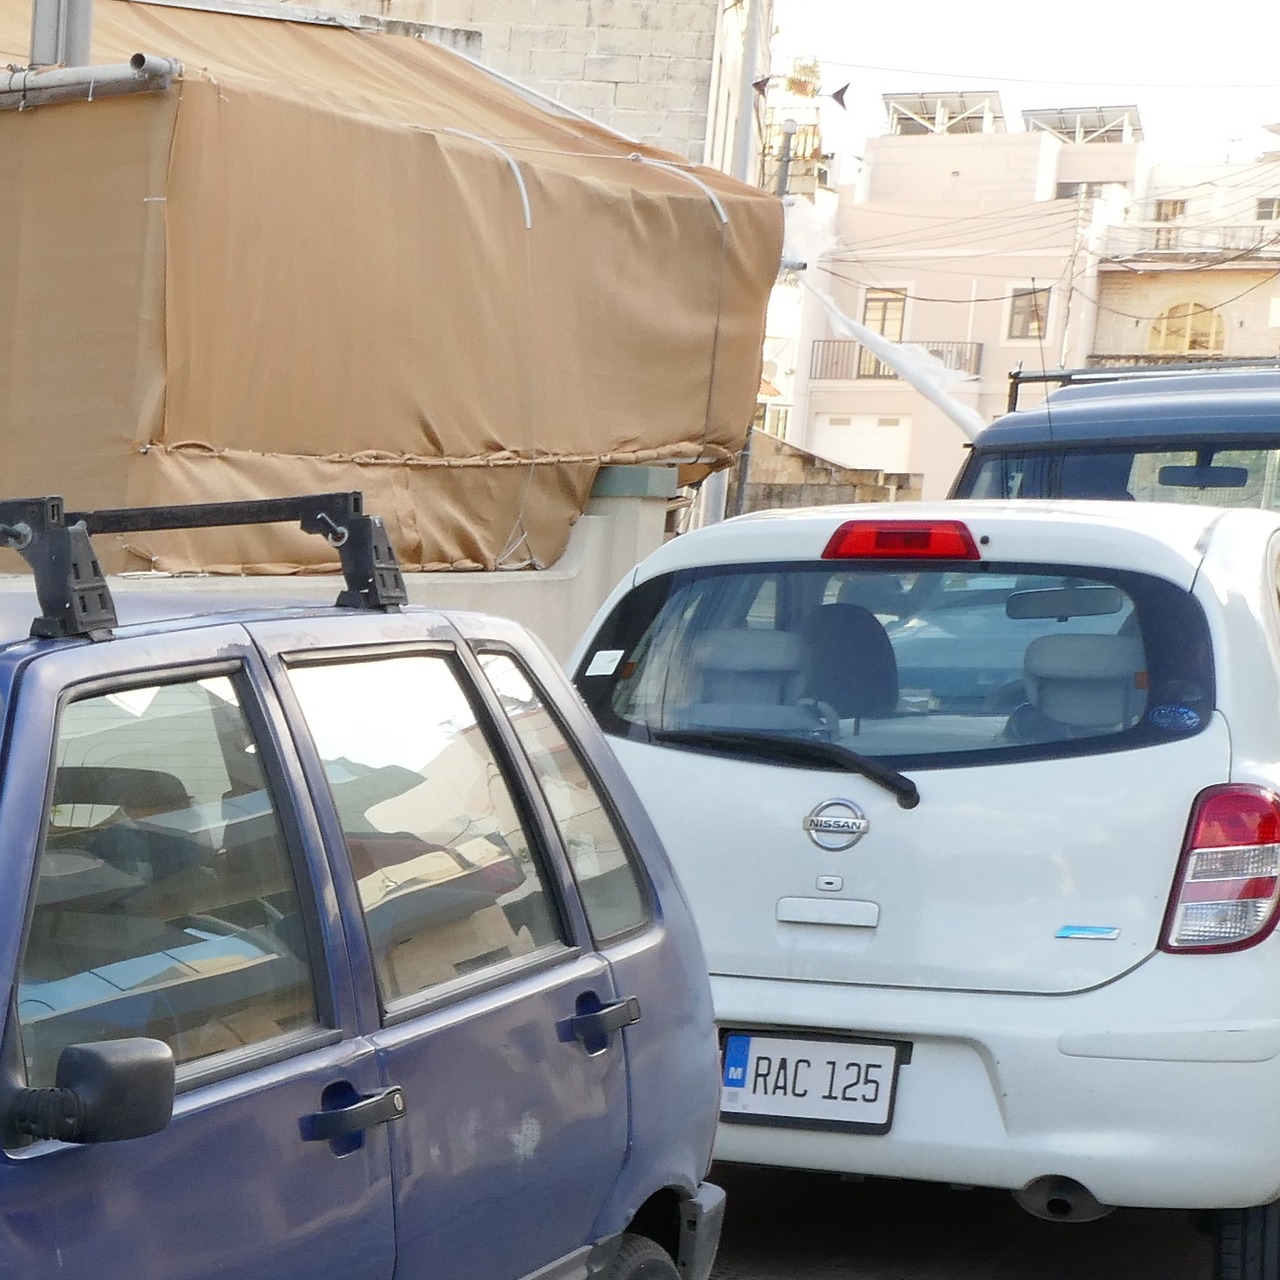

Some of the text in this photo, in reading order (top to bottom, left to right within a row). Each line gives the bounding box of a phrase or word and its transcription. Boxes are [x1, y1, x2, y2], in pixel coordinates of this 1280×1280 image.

[809, 819, 862, 830] NISSAN
[728, 1066, 742, 1080] M
[752, 1056, 882, 1103] RAC 125
